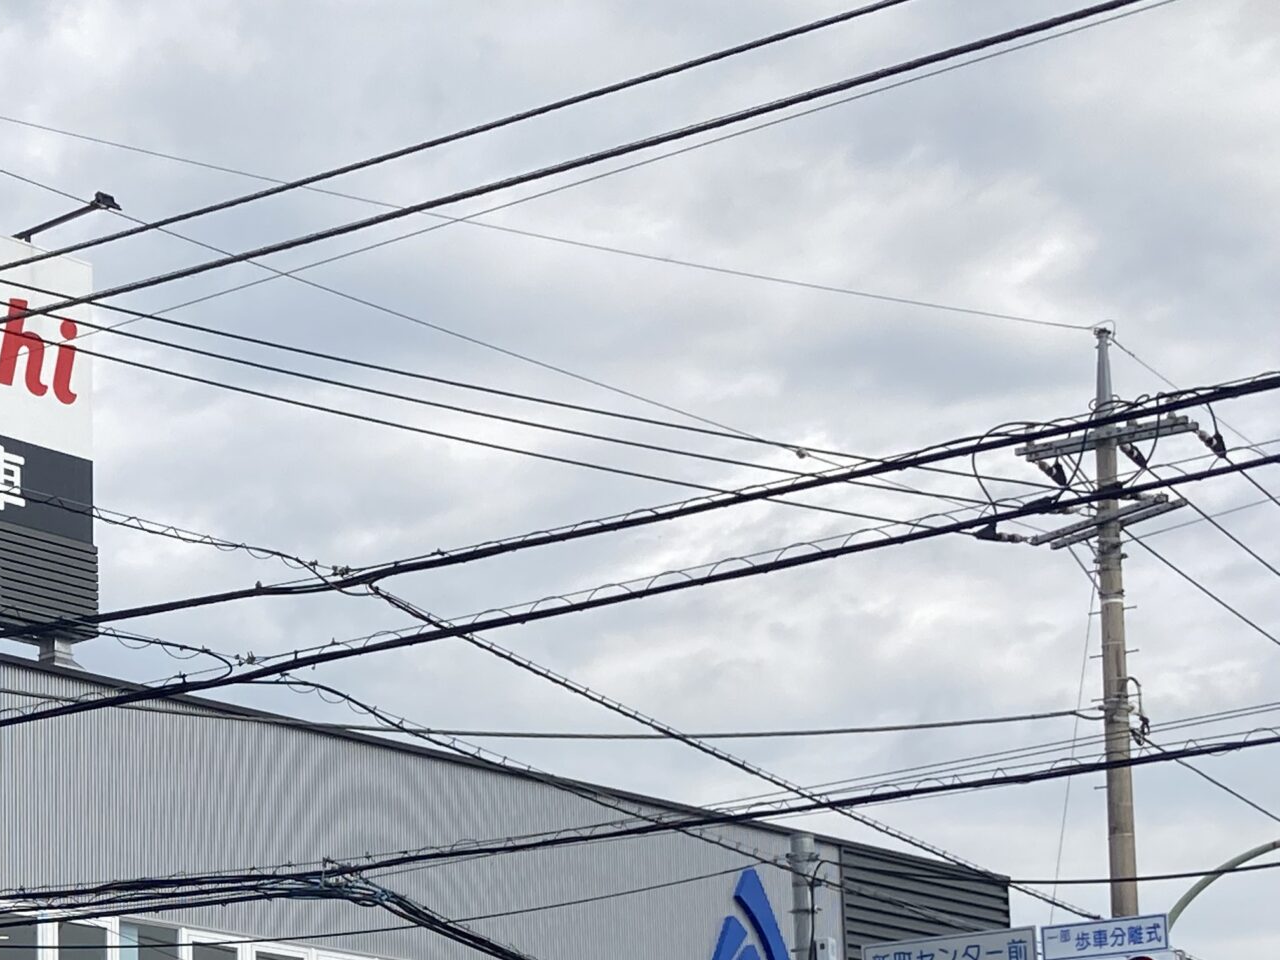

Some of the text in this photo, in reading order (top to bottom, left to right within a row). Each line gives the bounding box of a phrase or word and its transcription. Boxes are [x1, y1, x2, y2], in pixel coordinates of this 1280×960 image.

[1075, 923, 1161, 951] 歩車分離式
